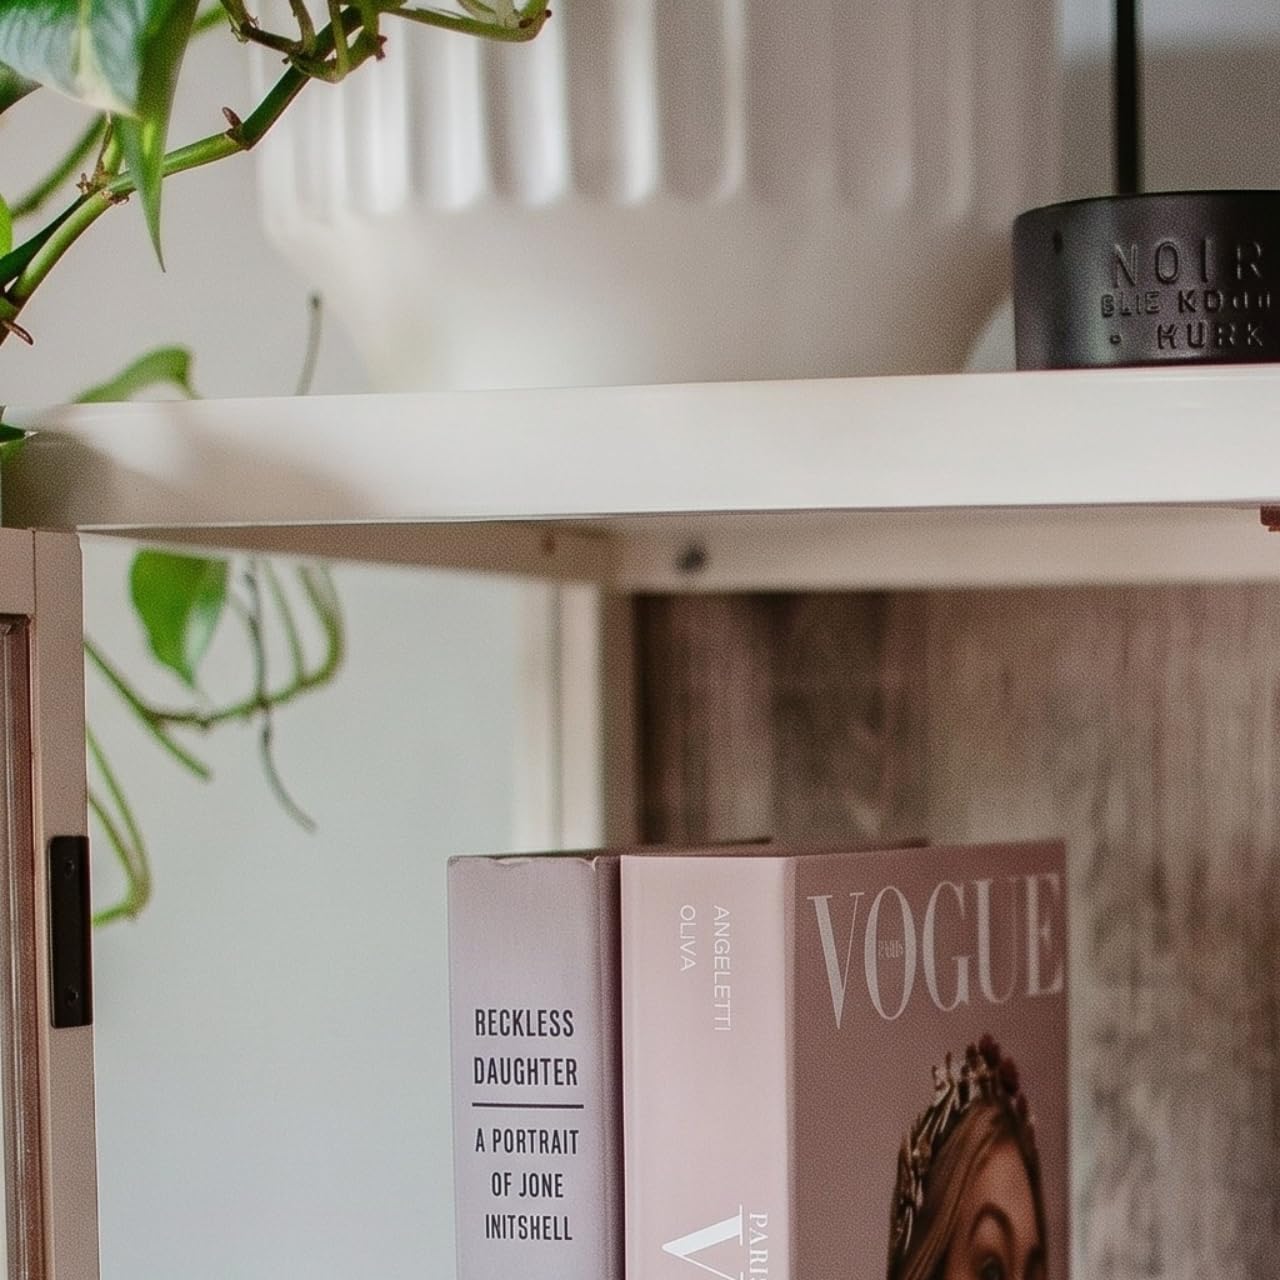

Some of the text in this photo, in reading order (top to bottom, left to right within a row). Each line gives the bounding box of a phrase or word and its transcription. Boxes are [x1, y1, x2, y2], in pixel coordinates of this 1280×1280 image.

[1111, 240, 1263, 288] NOIR
[680, 905, 697, 972] OLIVA
[807, 872, 1064, 1030] VOGUE
[714, 905, 731, 1030] ANGELETTI
[475, 1009, 575, 1037] RECKLESS
[474, 1057, 578, 1085] DAUGHTER
[475, 1128, 579, 1154] A PORTRAIT
[491, 1172, 564, 1198] OF JONE
[485, 1214, 573, 1240] INITSHELL
